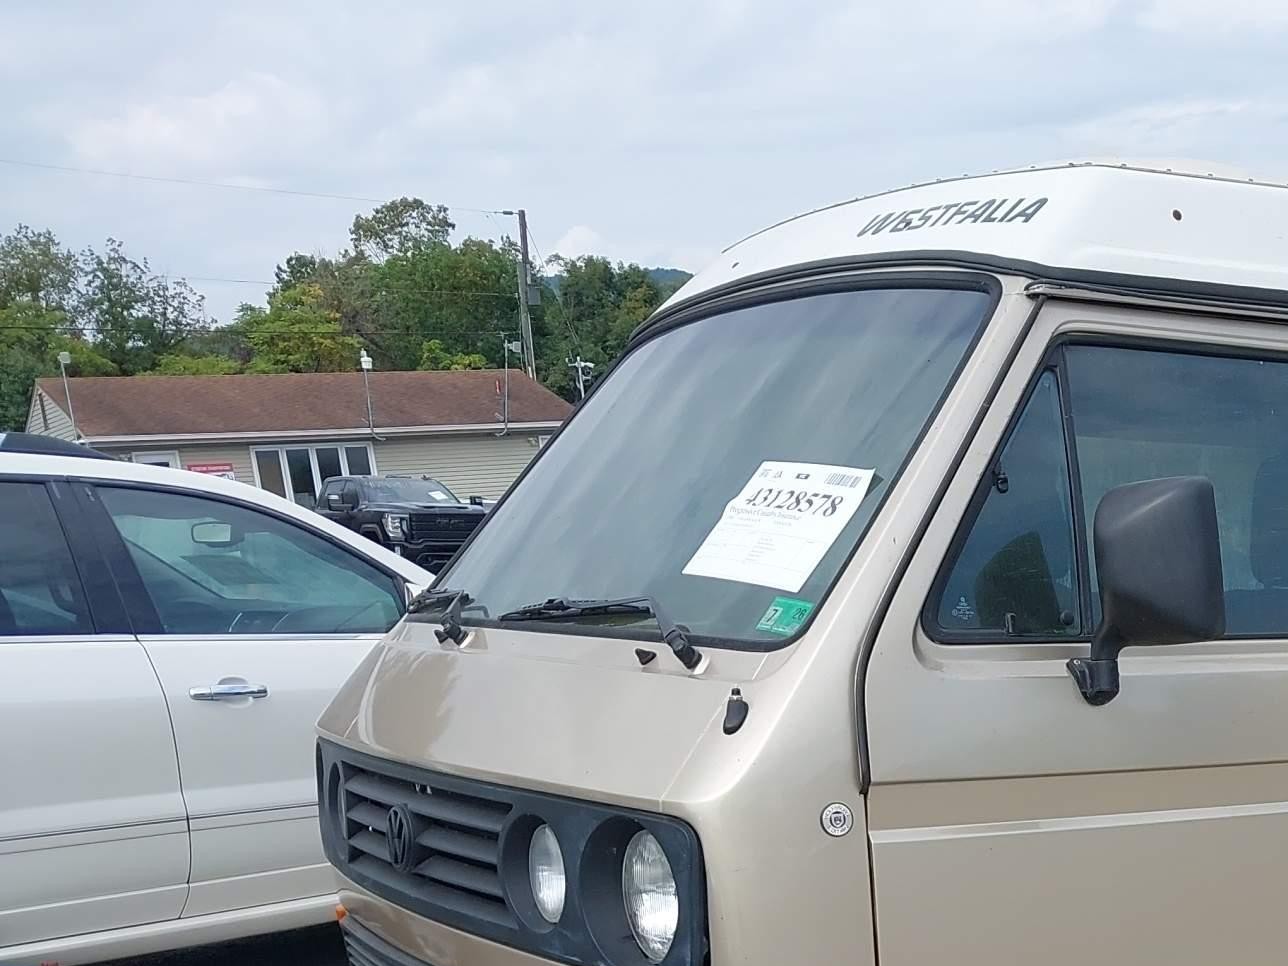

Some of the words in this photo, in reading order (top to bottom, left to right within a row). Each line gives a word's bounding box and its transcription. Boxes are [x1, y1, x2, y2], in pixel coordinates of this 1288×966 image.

[857, 198, 1049, 237] WESTFALIA
[745, 487, 844, 517] 43128578
[766, 609, 778, 623] 7
